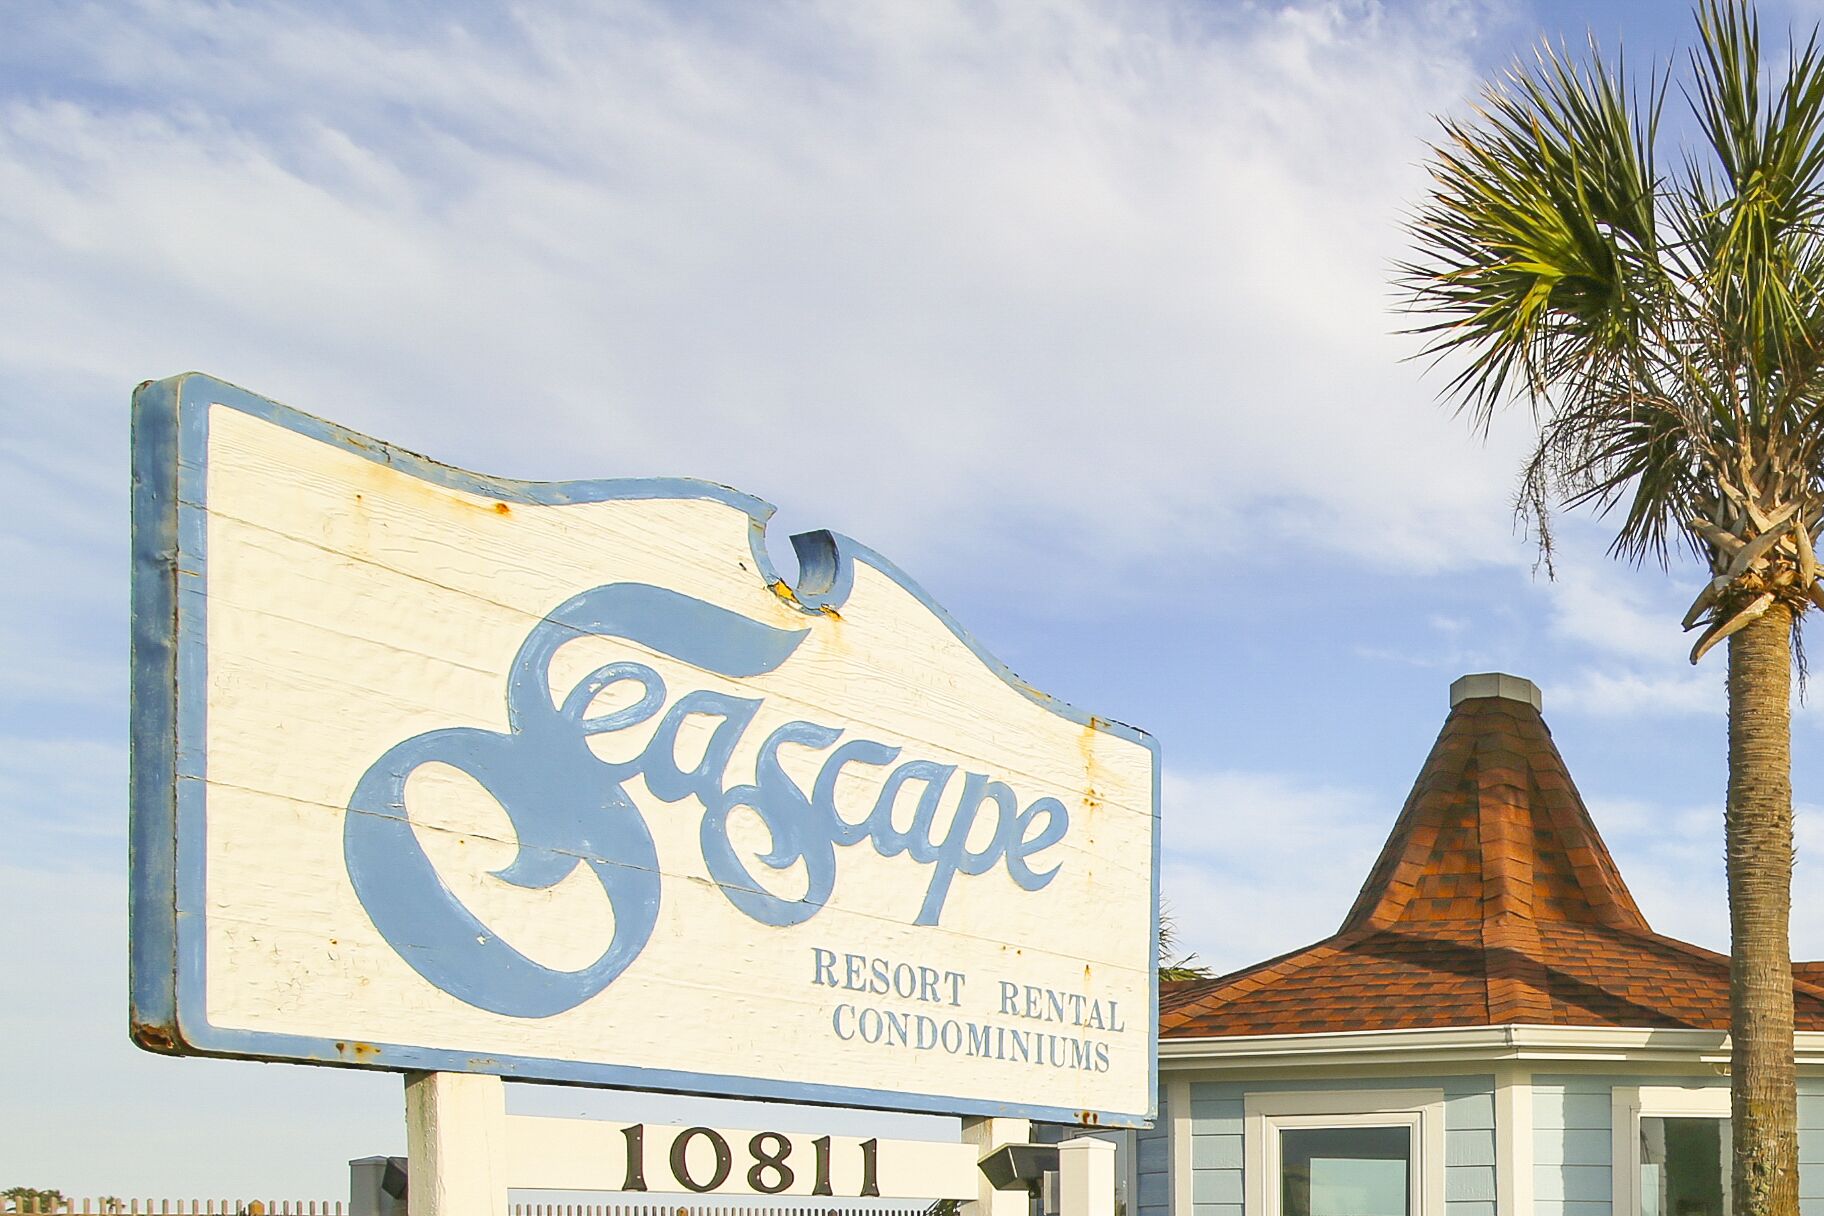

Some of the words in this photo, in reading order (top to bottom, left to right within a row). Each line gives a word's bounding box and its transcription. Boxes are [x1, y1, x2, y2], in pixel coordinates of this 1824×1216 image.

[343, 581, 1070, 1018] Seascape
[811, 947, 966, 1007] RESORT
[998, 980, 1125, 1033] RENTAL
[832, 1003, 1110, 1074] CONDOMINIUMS
[620, 1123, 880, 1197] 10811
